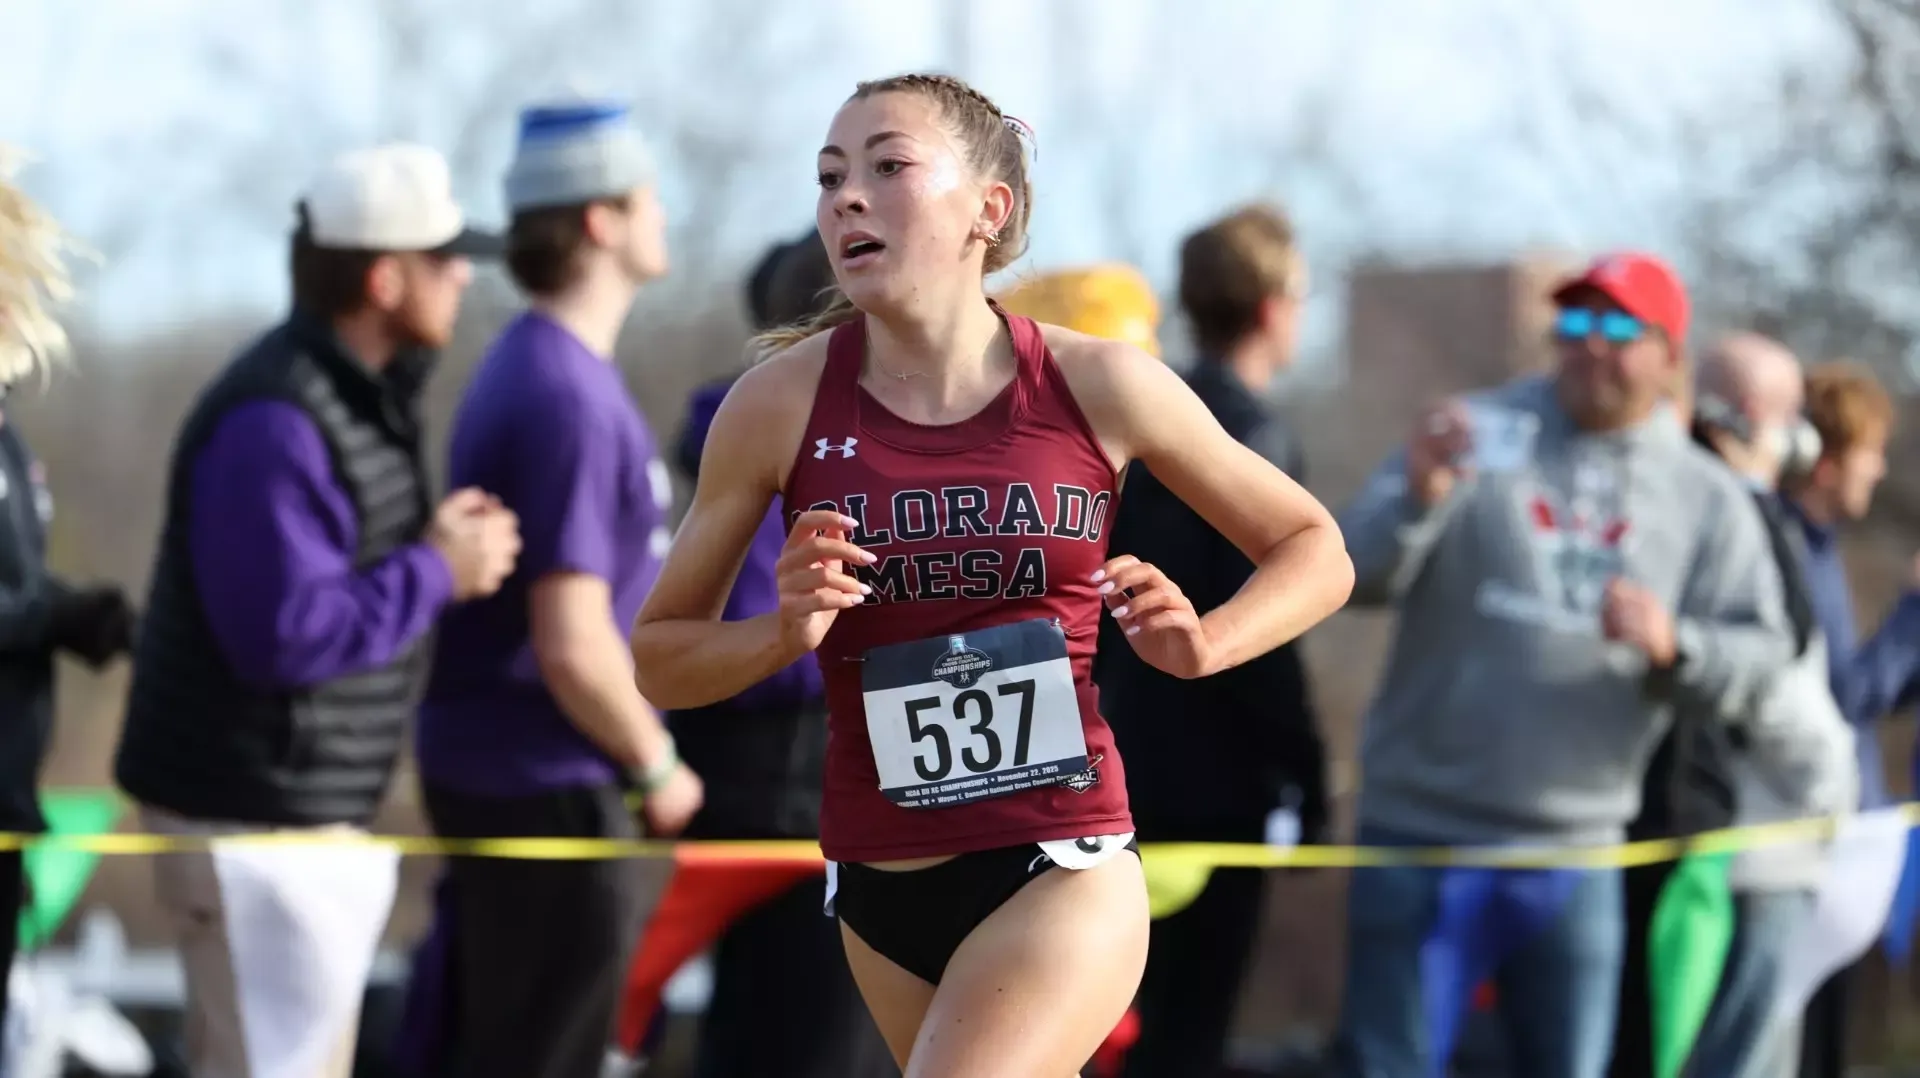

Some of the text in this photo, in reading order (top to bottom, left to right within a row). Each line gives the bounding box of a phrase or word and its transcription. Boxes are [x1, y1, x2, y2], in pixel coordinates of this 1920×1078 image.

[792, 483, 1110, 547] LORADO
[851, 547, 1047, 605] MESA
[934, 659, 990, 676] CHAMPIONSHIPS
[904, 679, 1035, 781] 537
[937, 795, 957, 803] Wayne
[989, 784, 1014, 793] National
[1014, 781, 1032, 790] Cross
[1032, 777, 1055, 786] Country
[940, 778, 988, 792] CHAMPIONSHIPS
[997, 772, 1029, 782] November
[1030, 769, 1041, 777] 22,
[1042, 765, 1059, 774] 2025
[1063, 771, 1097, 784] MAC
